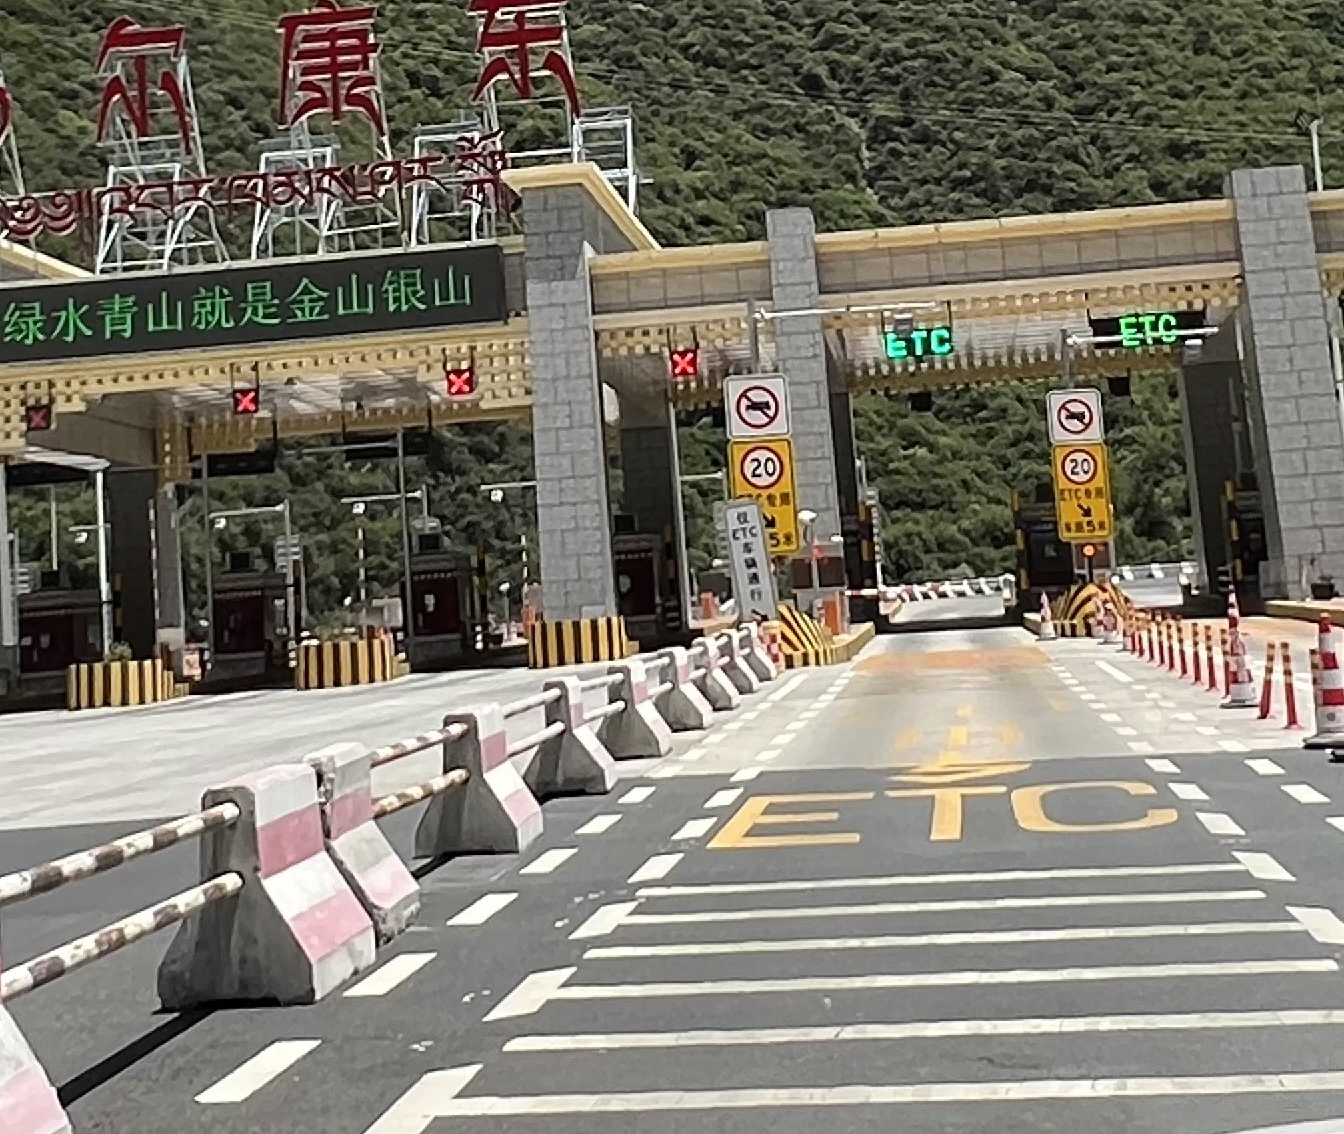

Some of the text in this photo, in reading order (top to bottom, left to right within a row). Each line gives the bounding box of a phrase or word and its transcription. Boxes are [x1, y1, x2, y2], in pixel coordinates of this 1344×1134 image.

[2, 265, 473, 346] 绿水青山就是金山银山
[884, 328, 954, 359] ETC
[1119, 314, 1178, 347] ETC
[750, 457, 777, 478] 20
[1070, 458, 1091, 476] 20
[706, 780, 1178, 850] ETC
